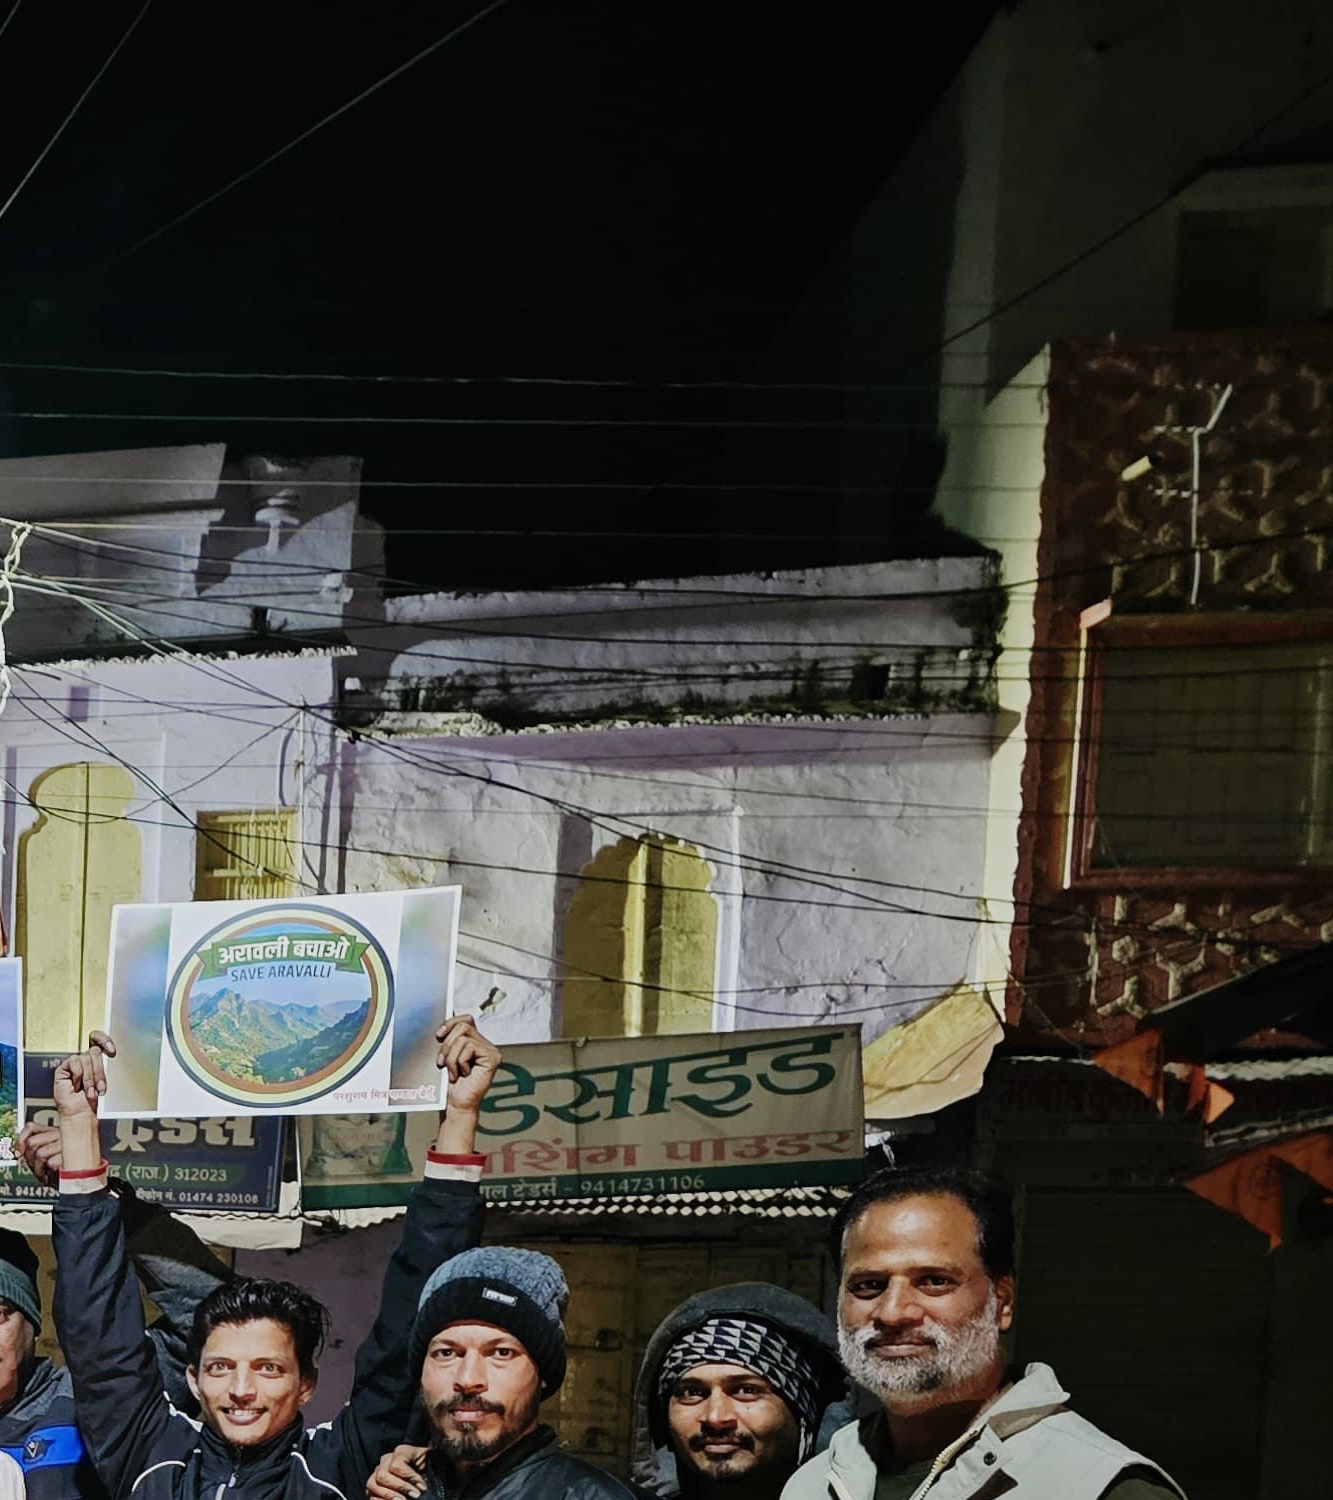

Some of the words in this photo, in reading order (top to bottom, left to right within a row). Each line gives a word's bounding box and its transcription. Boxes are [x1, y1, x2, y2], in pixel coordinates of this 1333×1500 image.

[218, 936, 289, 964] अरावली
[292, 934, 350, 961] बचाओ
[231, 964, 265, 983] SAVE
[269, 964, 332, 980] ARAVALLI
[661, 1129, 854, 1163] पाउडर
[174, 1168, 227, 1182] 312023
[581, 1174, 705, 1194] 9414731106
[179, 1192, 213, 1202] 01474
